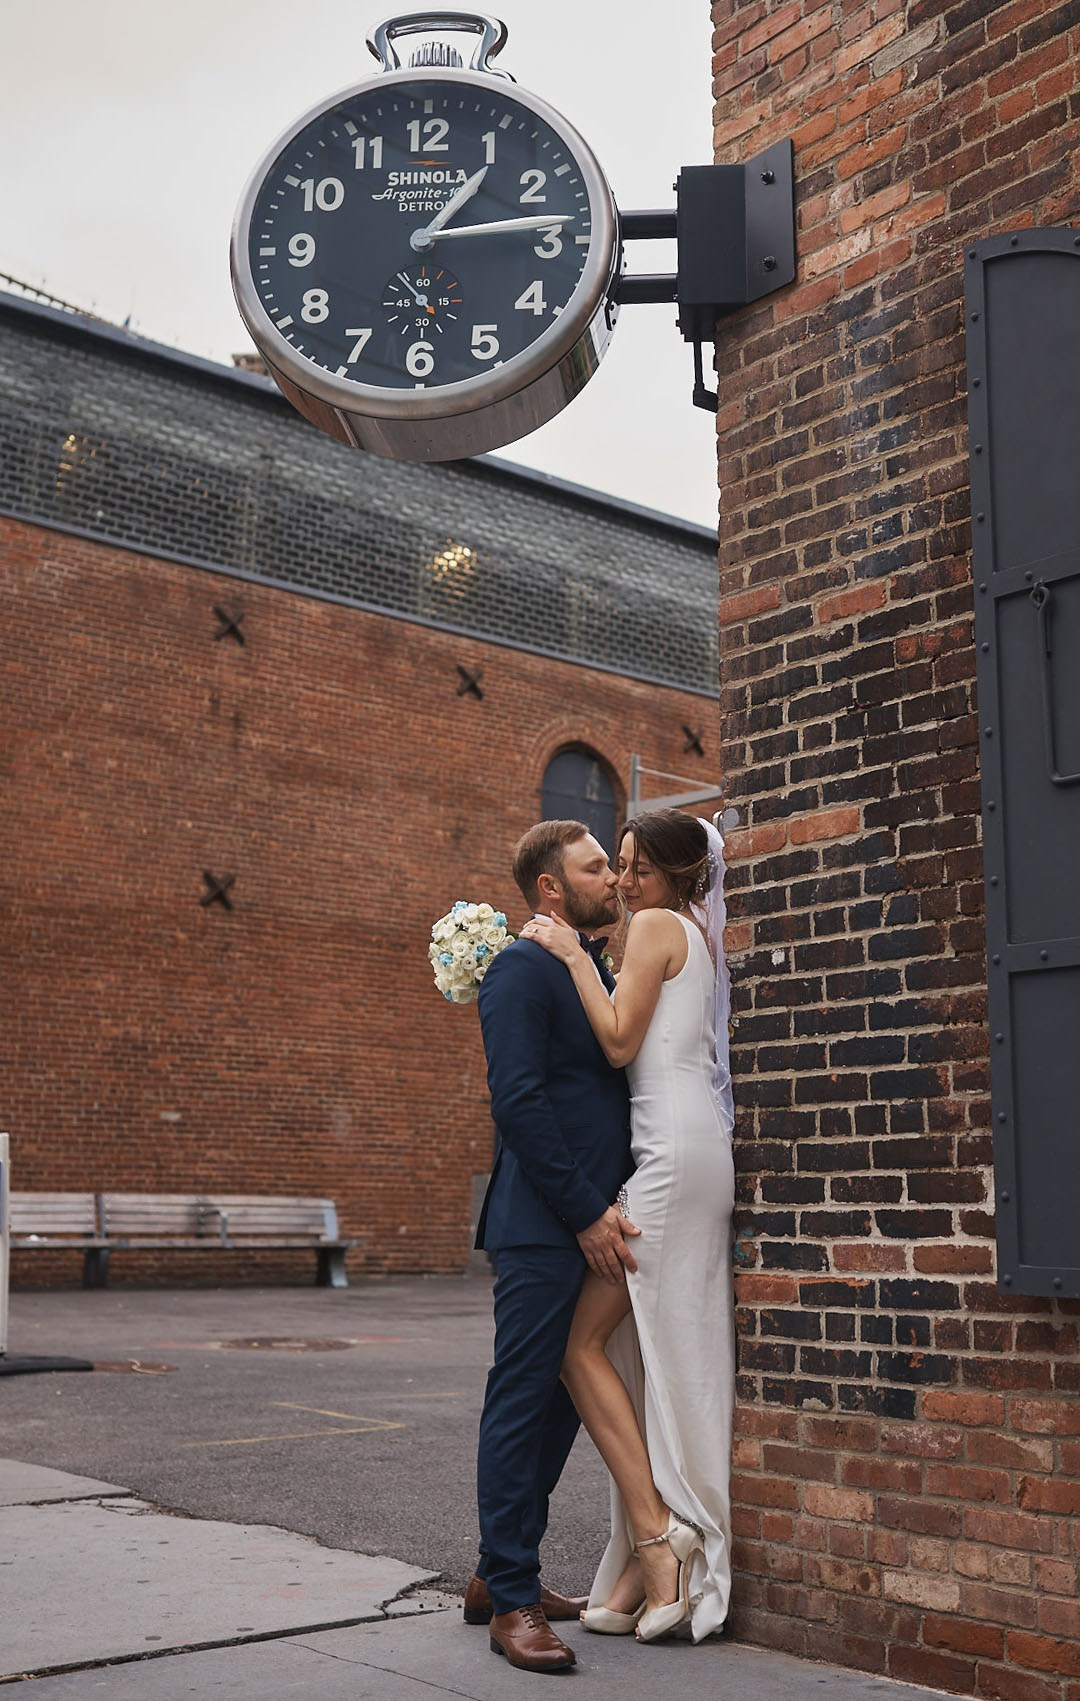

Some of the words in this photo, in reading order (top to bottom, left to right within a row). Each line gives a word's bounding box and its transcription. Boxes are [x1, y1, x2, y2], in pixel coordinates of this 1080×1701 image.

[350, 136, 384, 170] 11
[406, 118, 450, 153] 12
[481, 131, 496, 165] 1
[300, 177, 345, 212] 10
[388, 169, 468, 187] SHINOLA
[519, 168, 547, 204] 2
[398, 201, 449, 212] DETRO
[288, 233, 316, 268] 9
[533, 223, 563, 259] 3
[415, 278, 431, 288] 60
[514, 280, 548, 316] 4
[300, 288, 330, 324] 8
[395, 298, 411, 308] 45
[438, 297, 450, 306] 15
[415, 318, 430, 327] 30
[345, 327, 373, 364] 7
[405, 341, 435, 378] 6
[470, 323, 501, 361] 5
